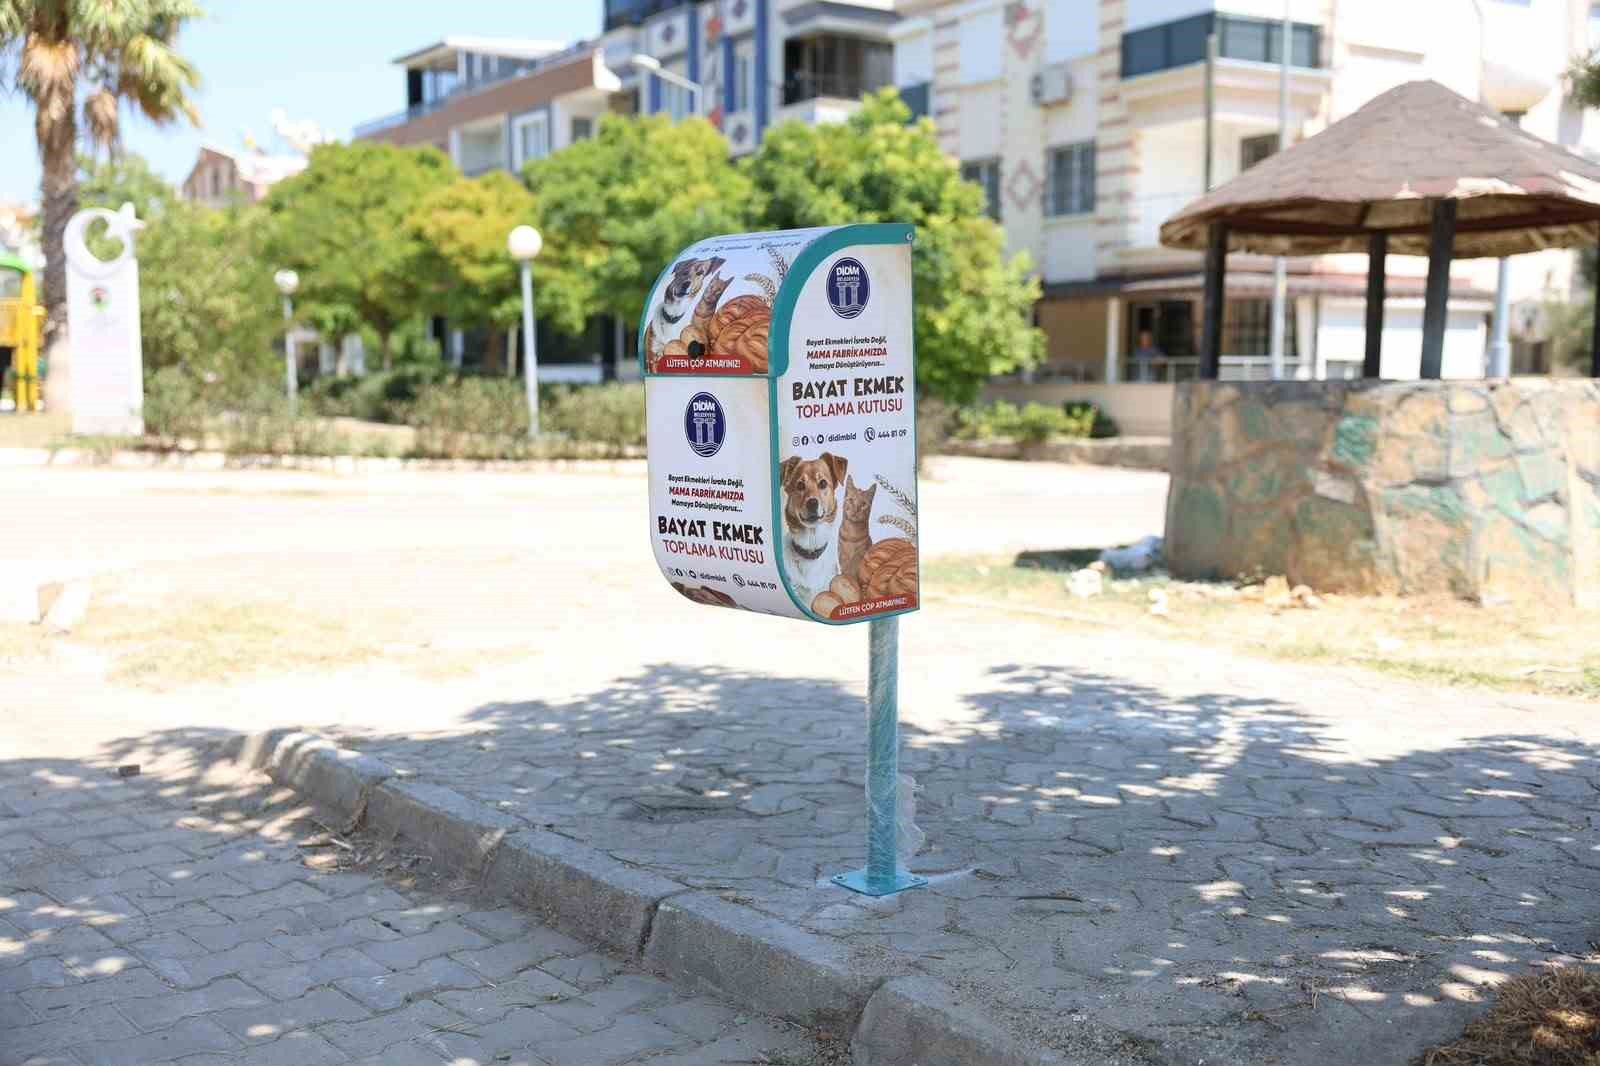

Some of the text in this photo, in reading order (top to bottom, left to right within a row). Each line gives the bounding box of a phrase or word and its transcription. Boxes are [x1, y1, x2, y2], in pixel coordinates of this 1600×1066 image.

[806, 338, 824, 347] Bayat
[825, 337, 853, 346] Ekmekleri
[807, 347, 887, 360] MAMA FABRİKAMIZDA
[809, 362, 835, 371] Mamaya
[792, 376, 904, 401] BAYAT EKMEK
[796, 399, 903, 419] TOPLAMA KUTUSU
[668, 474, 684, 484] Bayat
[684, 474, 710, 484] Ekmekleri
[668, 486, 745, 501] MAMA FABRİKAMIZDA
[671, 498, 694, 509] Mamaya
[658, 515, 764, 545] BAYAT EKMEK
[662, 539, 765, 565] TOPLAMA KUTUSU
